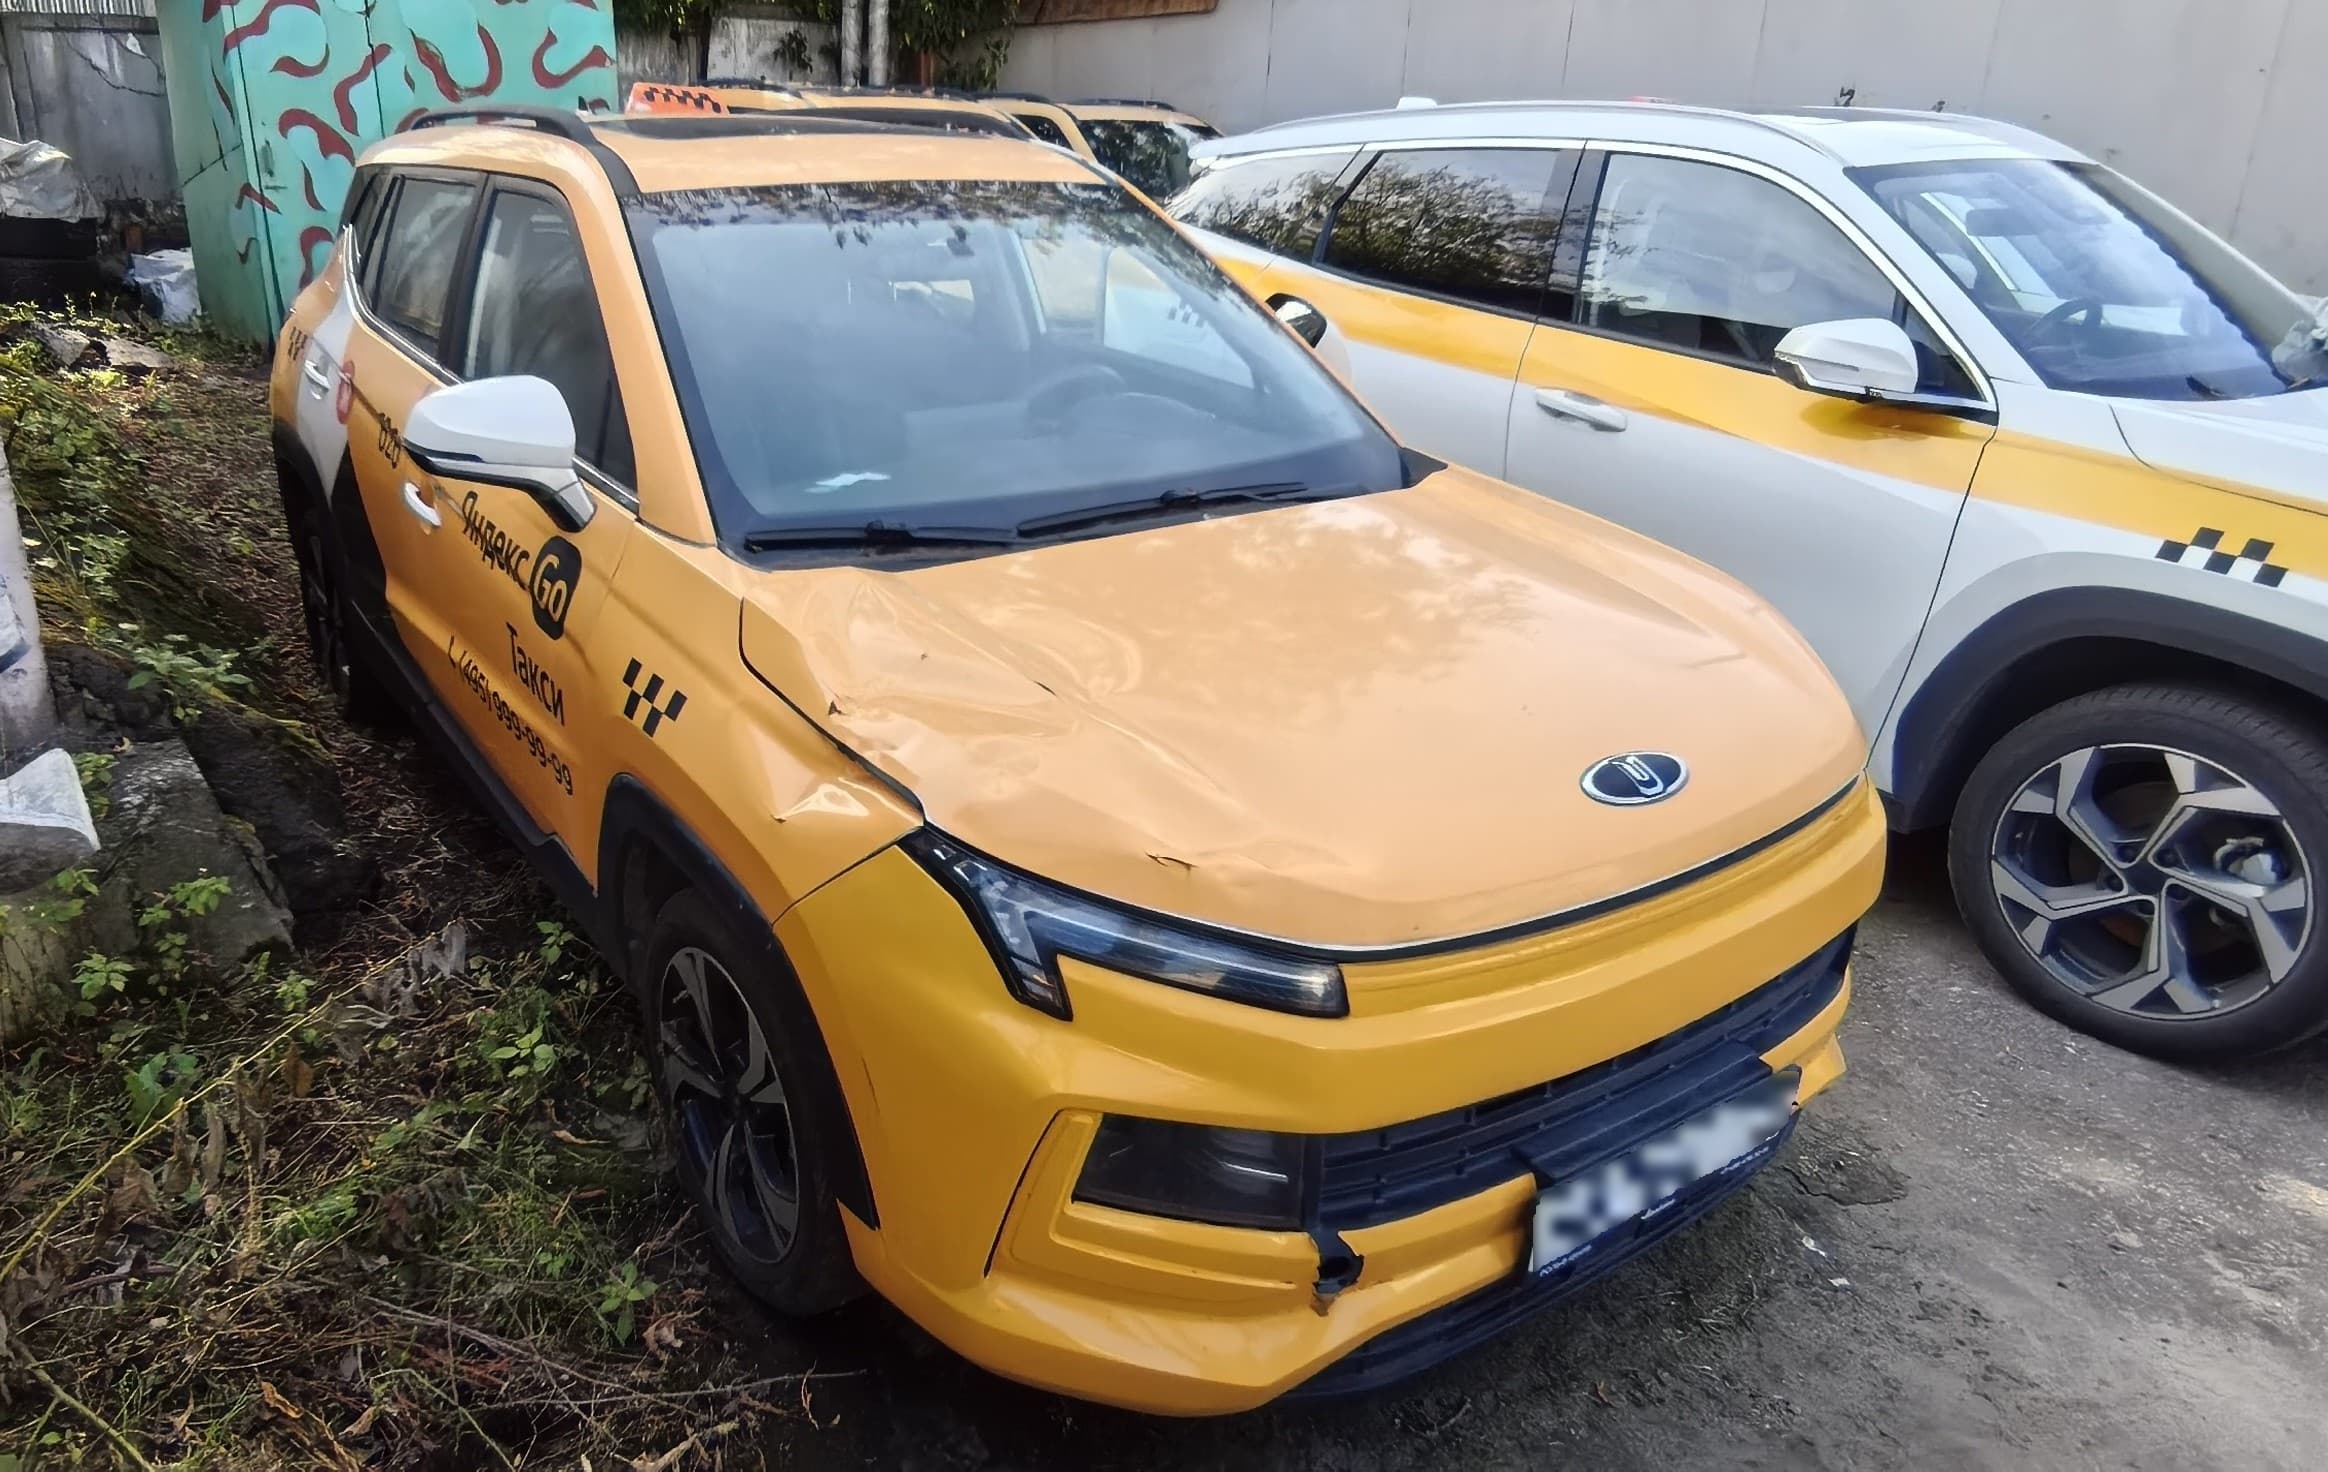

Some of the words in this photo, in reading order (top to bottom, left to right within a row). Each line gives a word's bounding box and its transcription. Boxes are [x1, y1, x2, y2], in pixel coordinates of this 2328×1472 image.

[462, 490, 530, 591] Яндекс
[533, 553, 567, 622] Go
[506, 621, 565, 727] Такси
